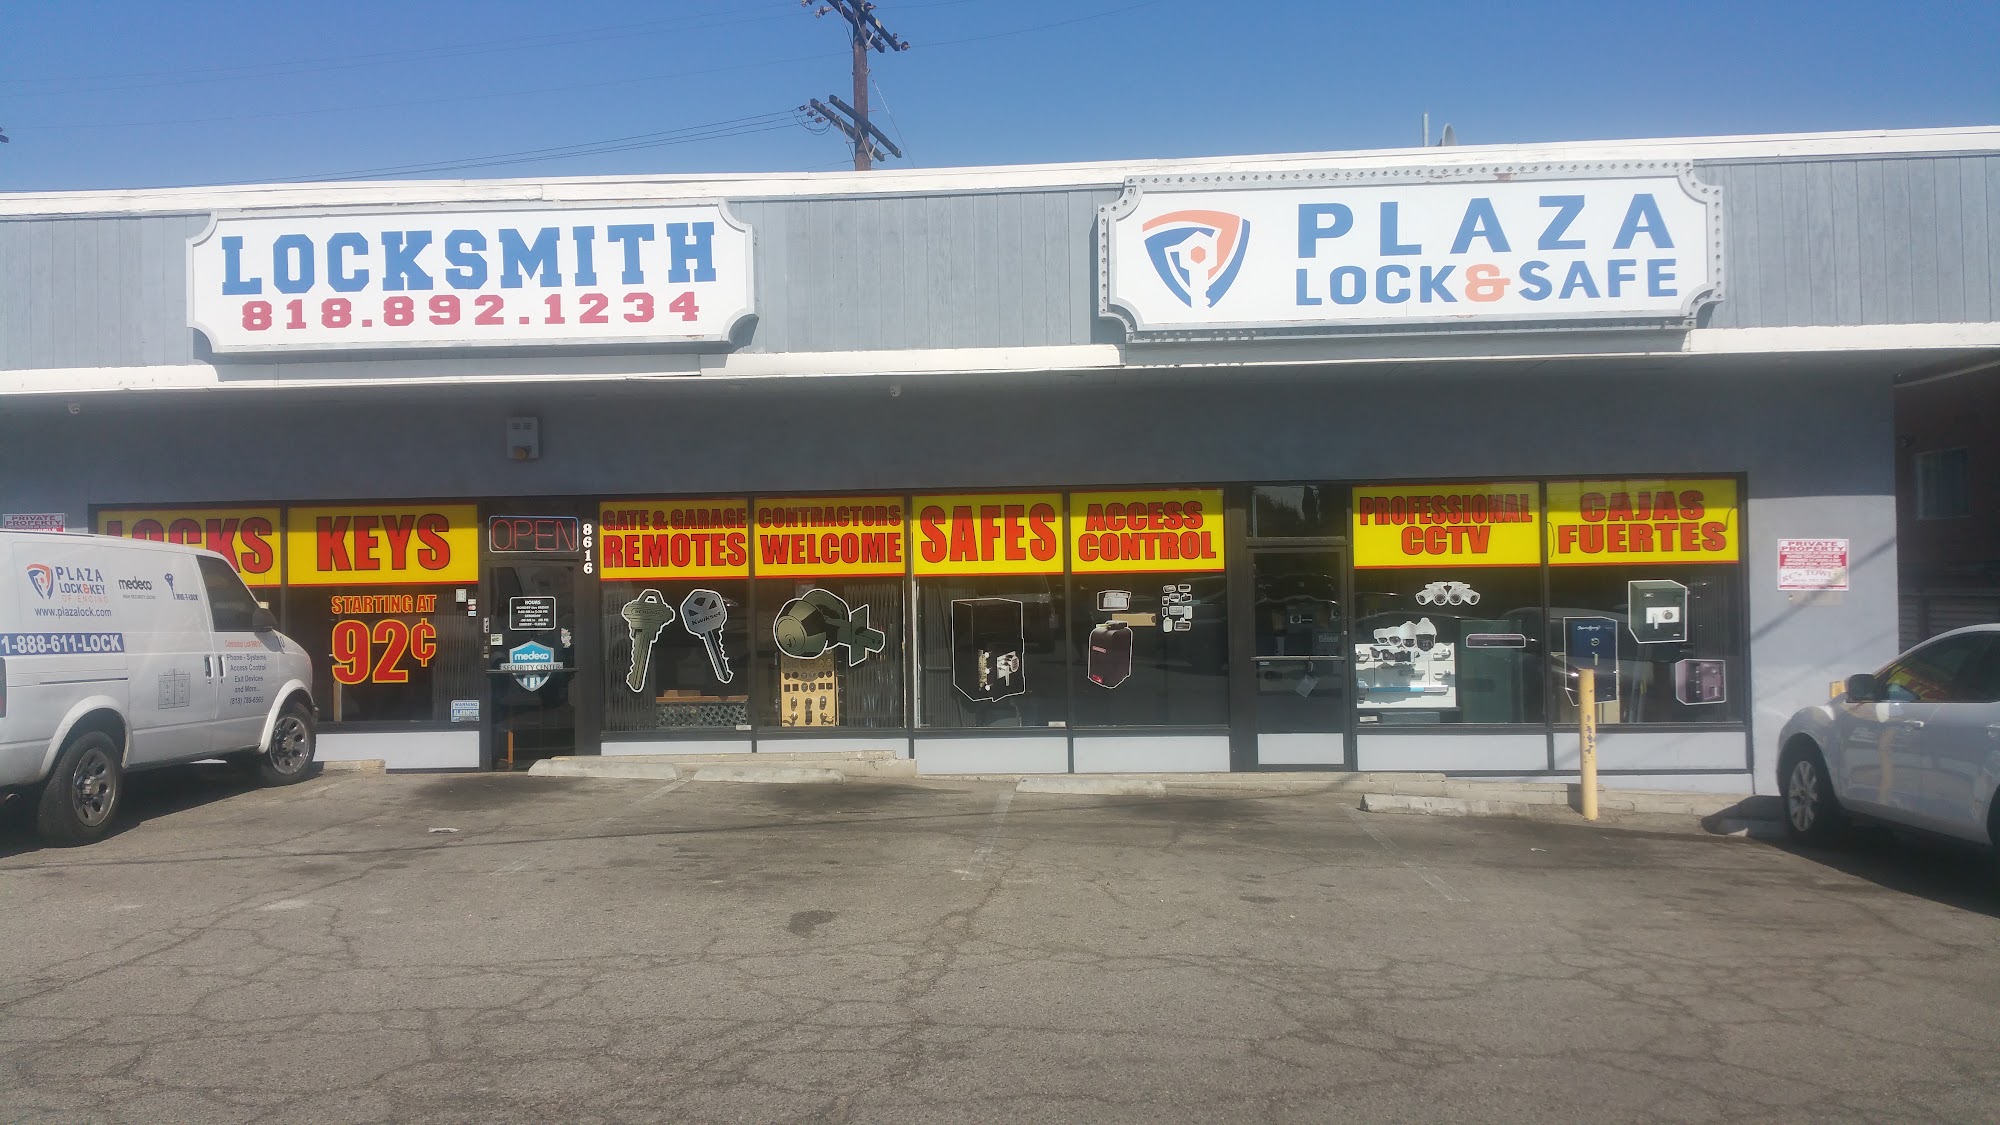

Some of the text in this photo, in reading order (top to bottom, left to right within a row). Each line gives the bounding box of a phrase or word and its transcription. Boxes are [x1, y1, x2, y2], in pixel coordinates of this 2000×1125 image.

[1298, 193, 1676, 259] PLAZA
[222, 222, 717, 295] LOCKSMITH
[1296, 257, 1679, 307] LOCK&SAFE
[242, 291, 700, 332] 818.892.1234
[602, 507, 747, 531] GATE & GARAGE
[758, 505, 901, 529] CONTRACTORS
[1085, 501, 1204, 532] ACCESS
[1359, 493, 1533, 526] PROFESSIONAL
[1580, 490, 1706, 523] CAJAS
[315, 513, 452, 572] KEYS
[492, 518, 576, 550] OPEN
[920, 502, 1057, 563] SAFES
[1078, 530, 1217, 562] CONTROL
[1401, 525, 1492, 556] CCTV
[1557, 521, 1728, 555] FUERTES
[582, 523, 593, 575] 8616
[603, 532, 747, 568] REMOTES
[760, 532, 902, 565] WELCOME
[55, 566, 104, 583] PLAZA
[58, 583, 106, 595] LOCK&KEY
[118, 575, 153, 591] medeco
[35, 606, 112, 619] www.plazalock.com
[330, 595, 413, 615] STARTING
[416, 594, 438, 613] AT
[691, 611, 722, 626] Kwikset
[1, 634, 122, 654] 1-888-611-LOCK
[247, 654, 267, 662] Systems
[330, 617, 438, 686] 92¢
[514, 650, 549, 661] medeco
[234, 675, 244, 683] Exit
[249, 663, 267, 671] Control
